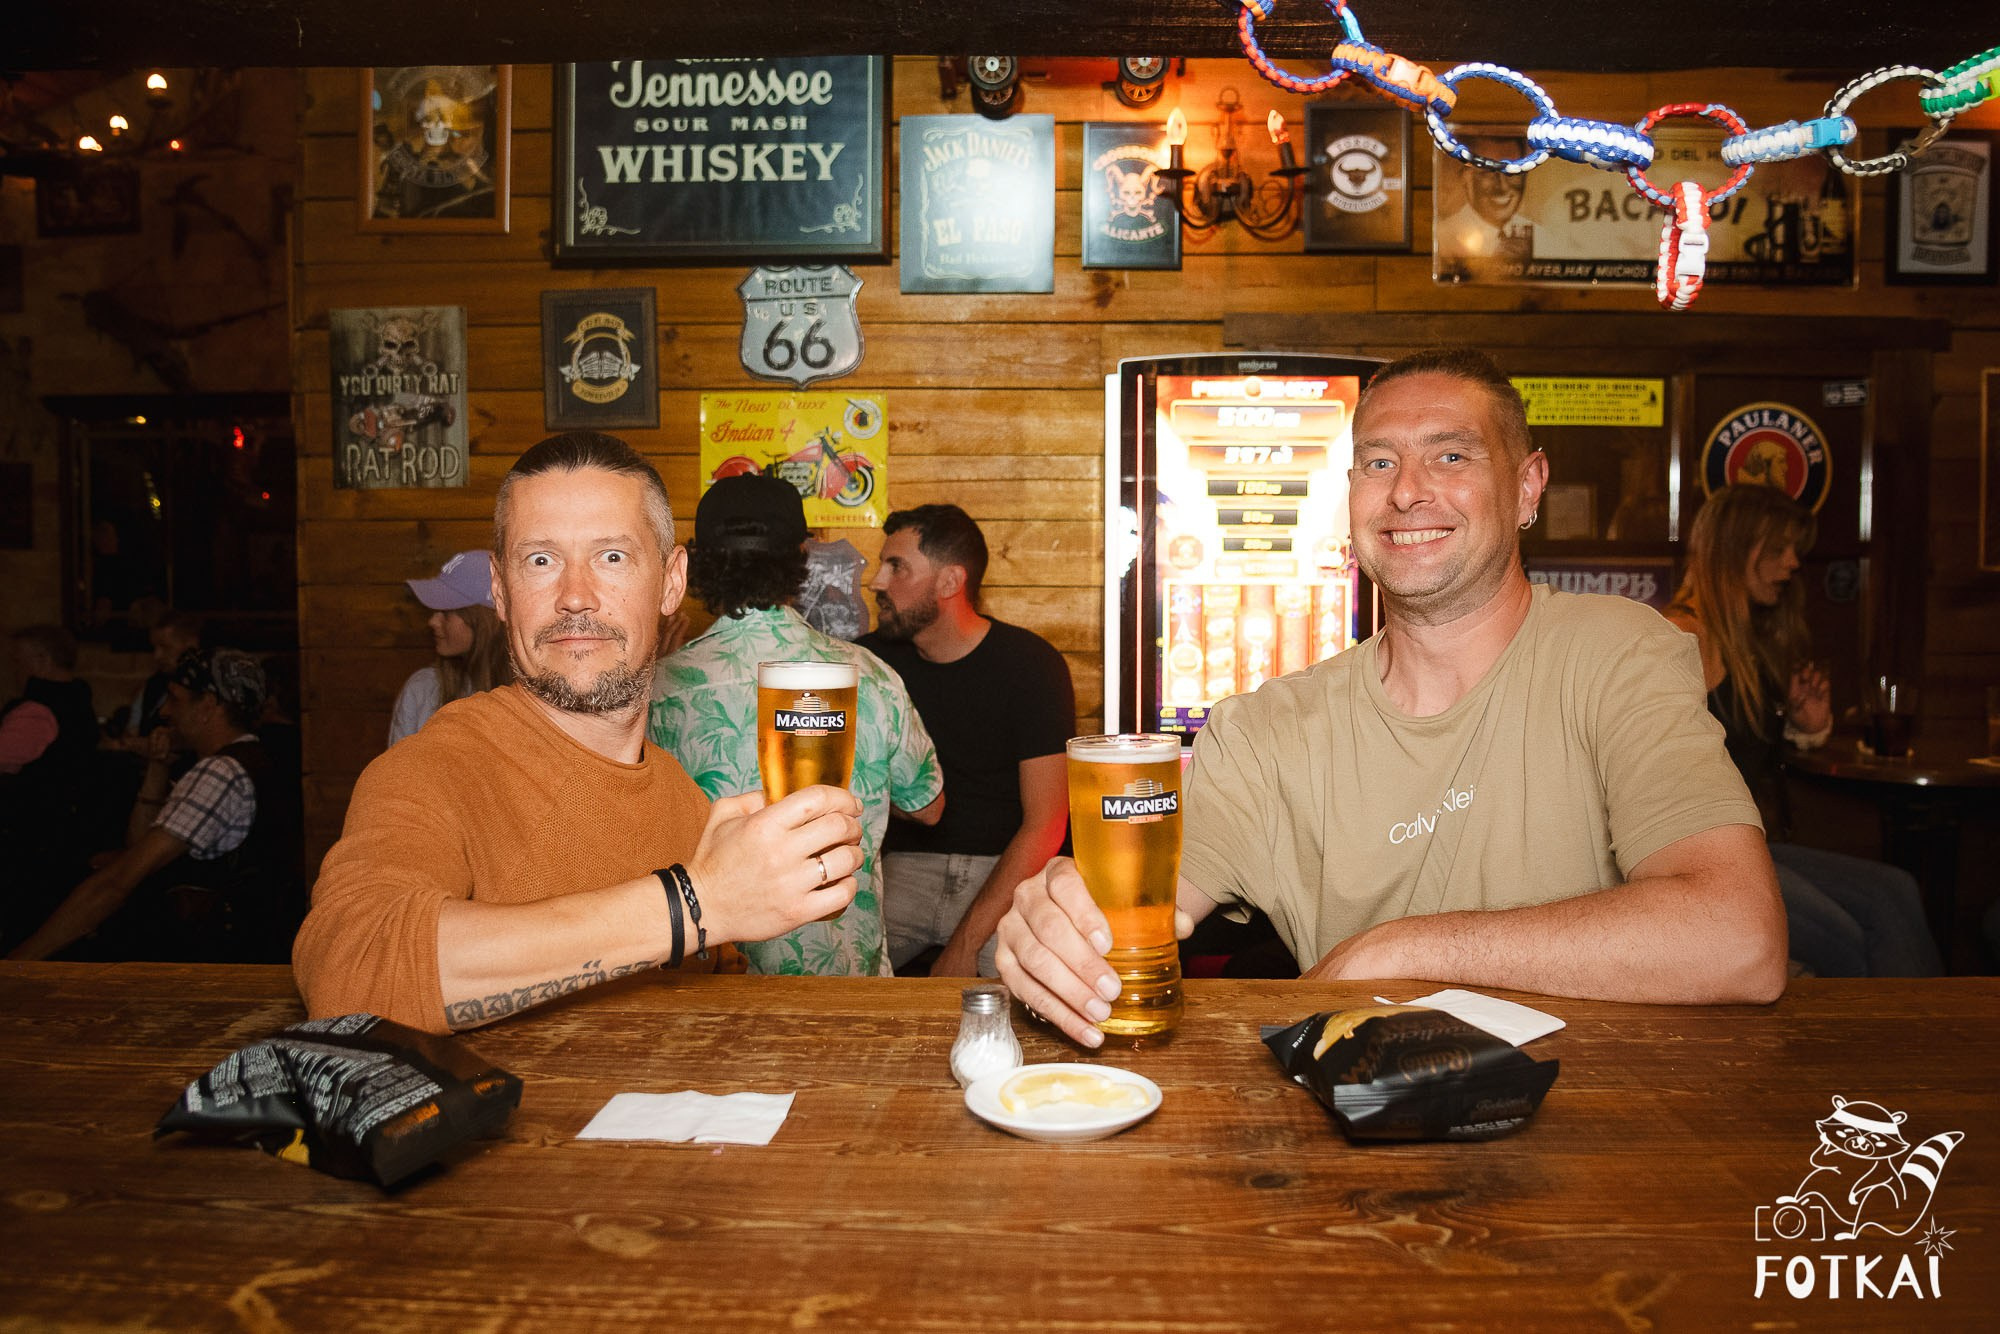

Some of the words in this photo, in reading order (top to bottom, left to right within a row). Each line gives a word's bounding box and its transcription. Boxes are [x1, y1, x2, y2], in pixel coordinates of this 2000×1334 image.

[609, 60, 834, 109] Tennessee
[633, 117, 710, 133] SOUR
[730, 115, 808, 132] MASH
[597, 142, 846, 184] WHISKEY
[922, 138, 966, 172] JACK
[932, 217, 962, 247] EL
[764, 276, 833, 297] ROUTE
[762, 319, 836, 371] 66
[376, 373, 422, 396] DIRTY
[429, 372, 459, 395] RAT
[735, 400, 772, 413] New
[711, 420, 776, 443] Indian
[1717, 409, 1824, 466] PAULANER
[347, 444, 395, 483] RAT
[402, 442, 460, 484] ROD
[776, 713, 845, 728] MAGNERS
[1103, 795, 1177, 815] MAGNERS
